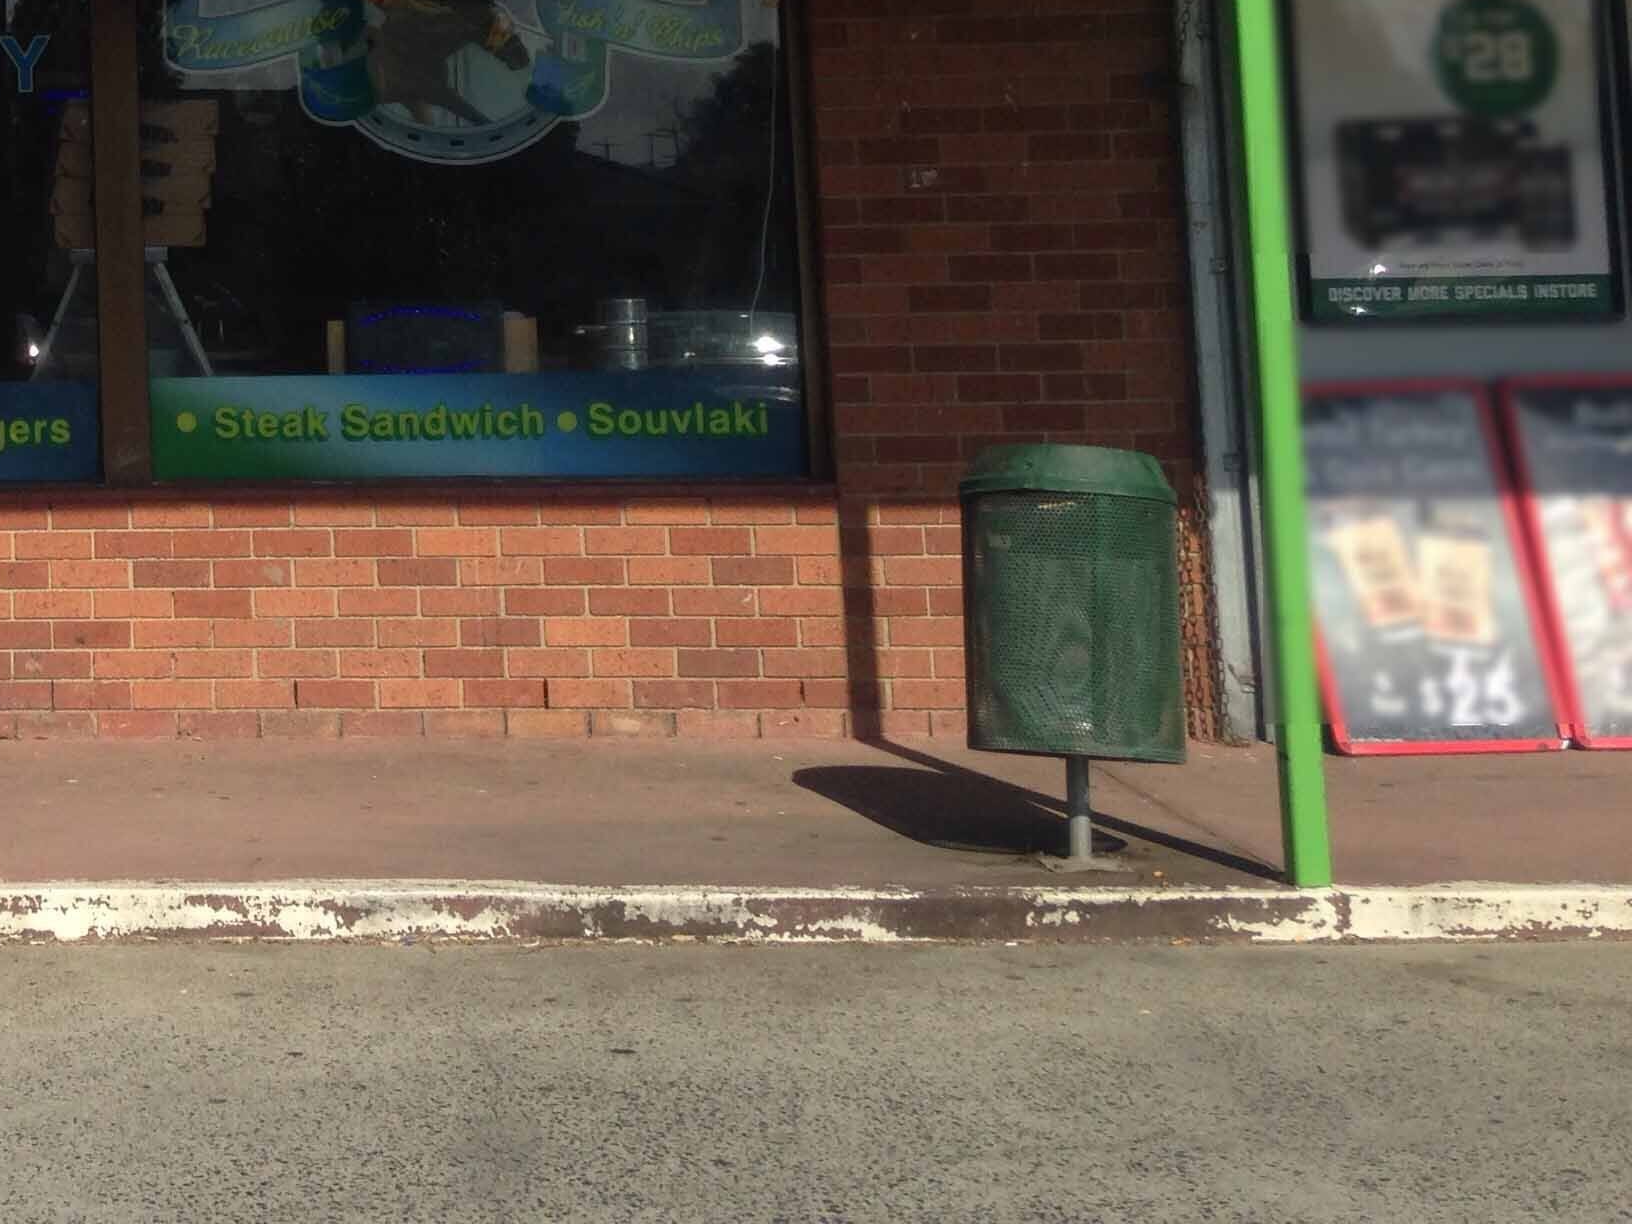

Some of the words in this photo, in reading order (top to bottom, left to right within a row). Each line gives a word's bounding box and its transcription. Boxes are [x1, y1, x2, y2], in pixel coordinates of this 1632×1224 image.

[1407, 284, 1449, 301] MORE
[1454, 283, 1528, 300] SPECIALS
[1533, 282, 1598, 299] INSTORE
[214, 404, 330, 441] Steak
[341, 401, 545, 440] Sandwich
[587, 400, 769, 438] Souvlaki
